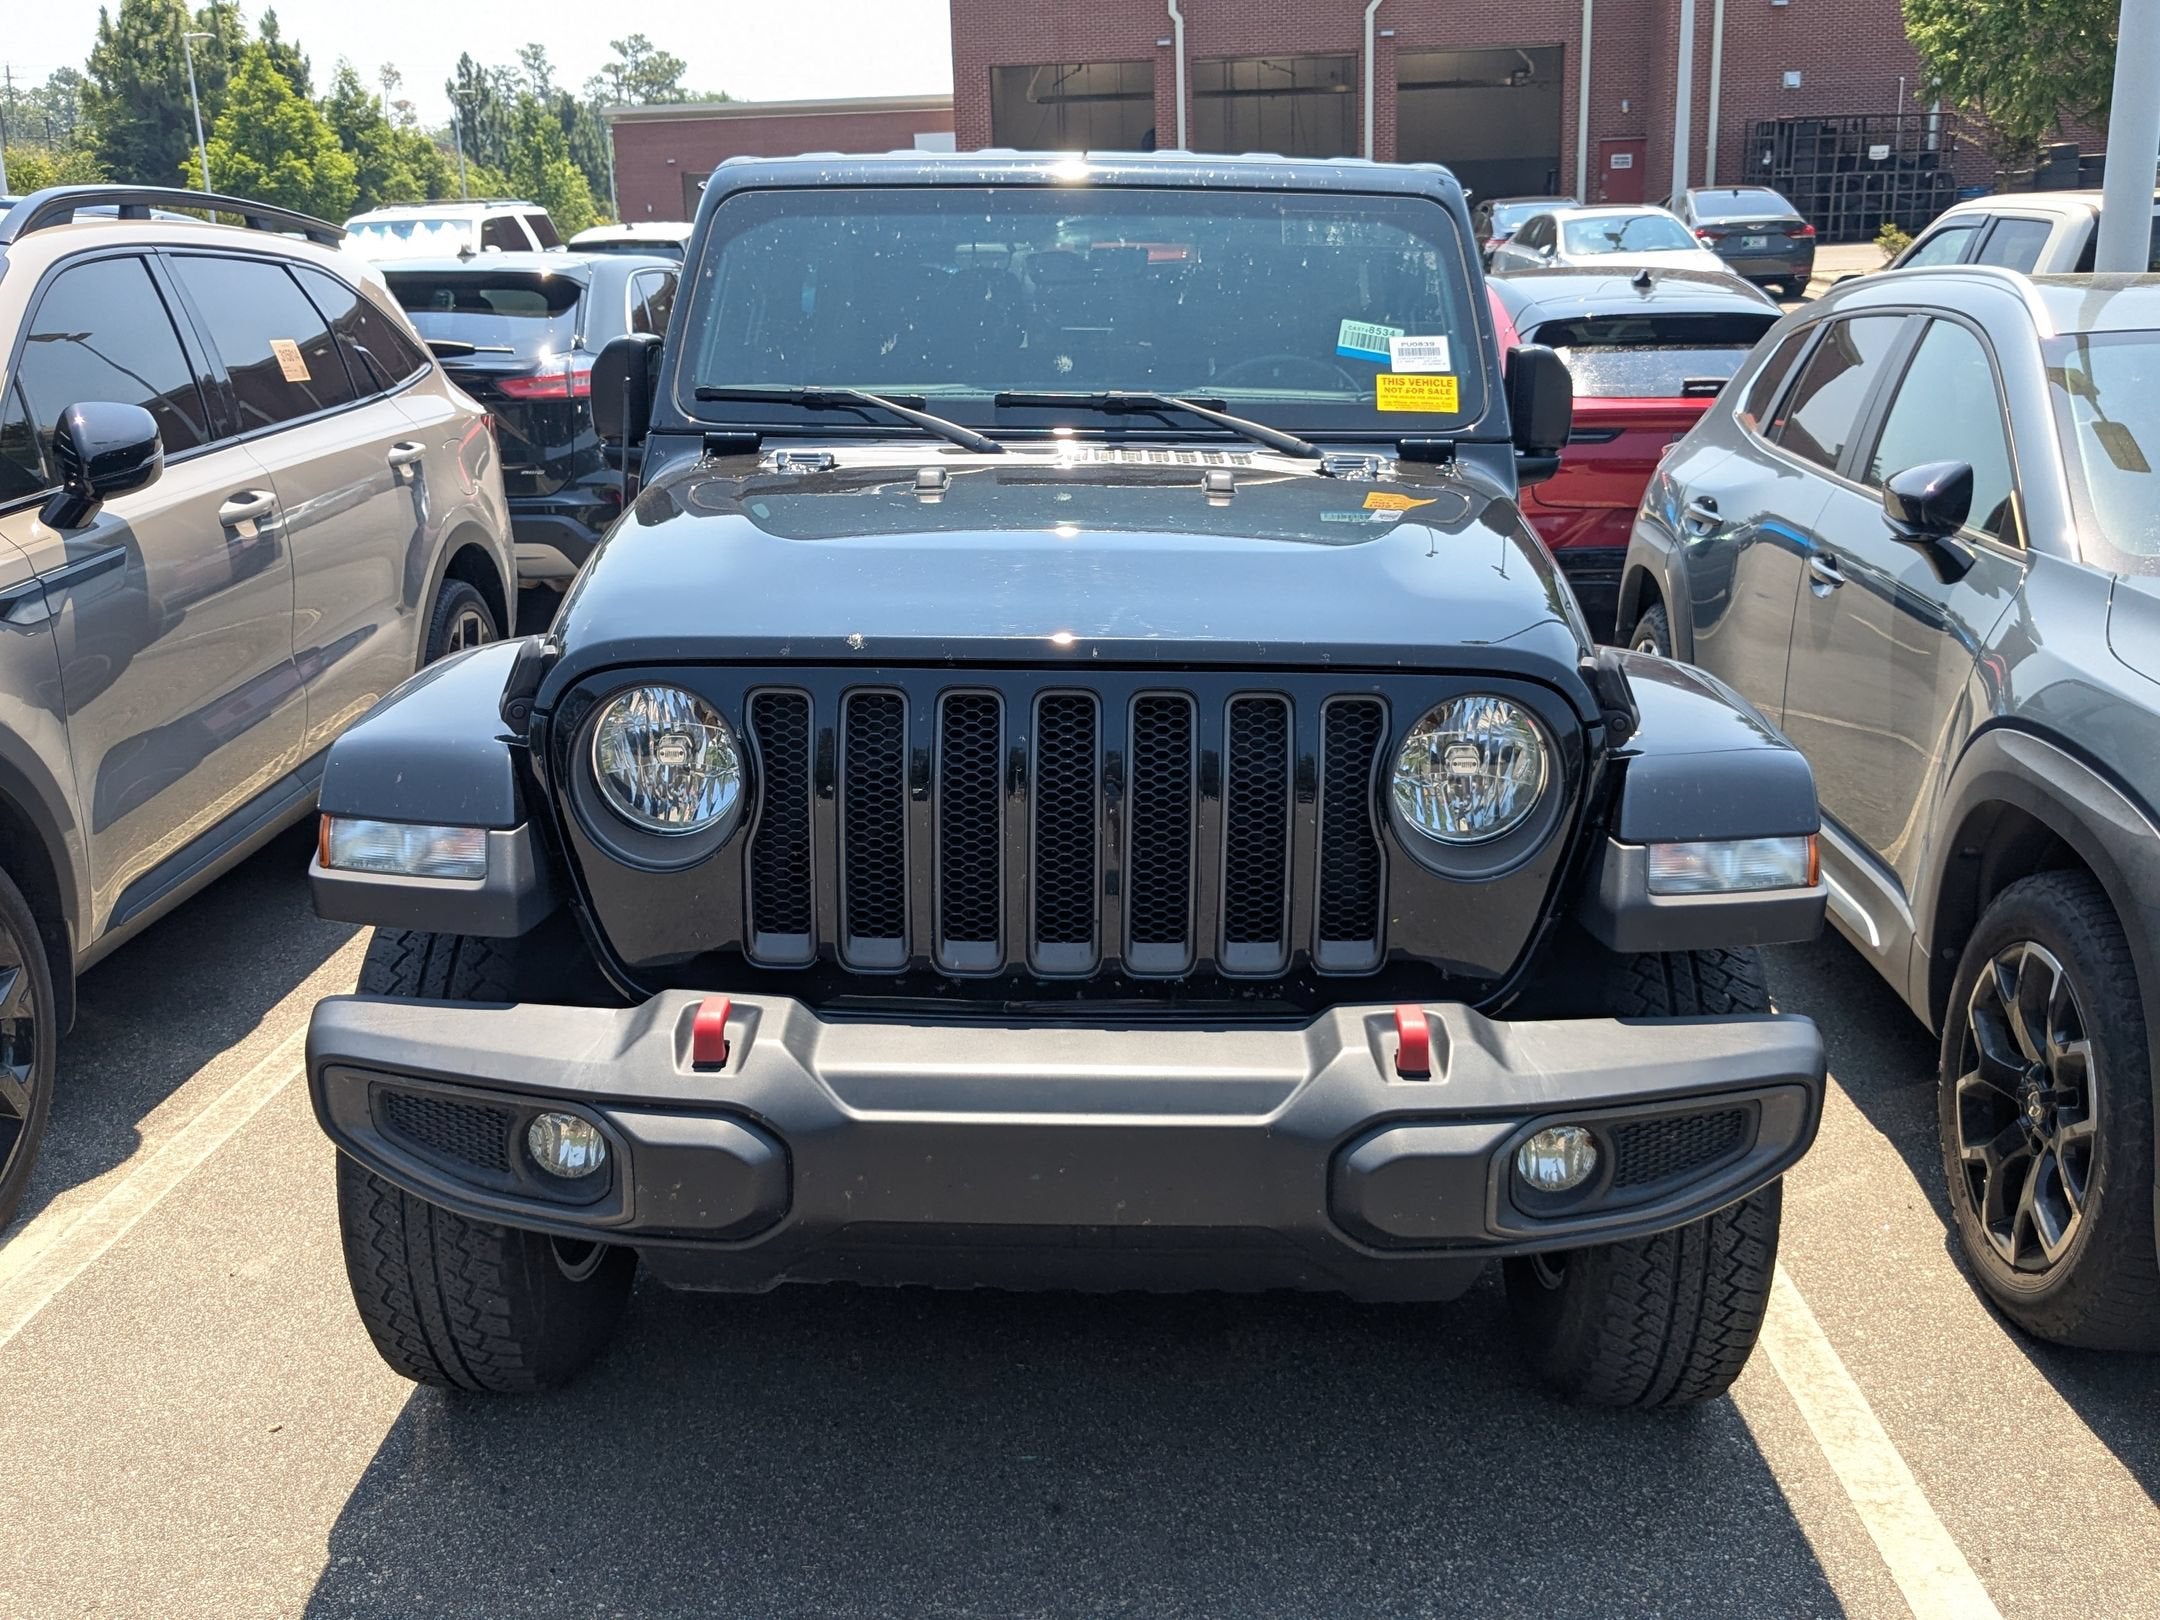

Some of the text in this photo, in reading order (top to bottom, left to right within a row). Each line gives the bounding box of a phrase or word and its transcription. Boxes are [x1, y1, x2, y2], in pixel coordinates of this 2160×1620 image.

[1381, 377, 1453, 388] THIS VEHICLE
[1405, 387, 1425, 395] FOR
